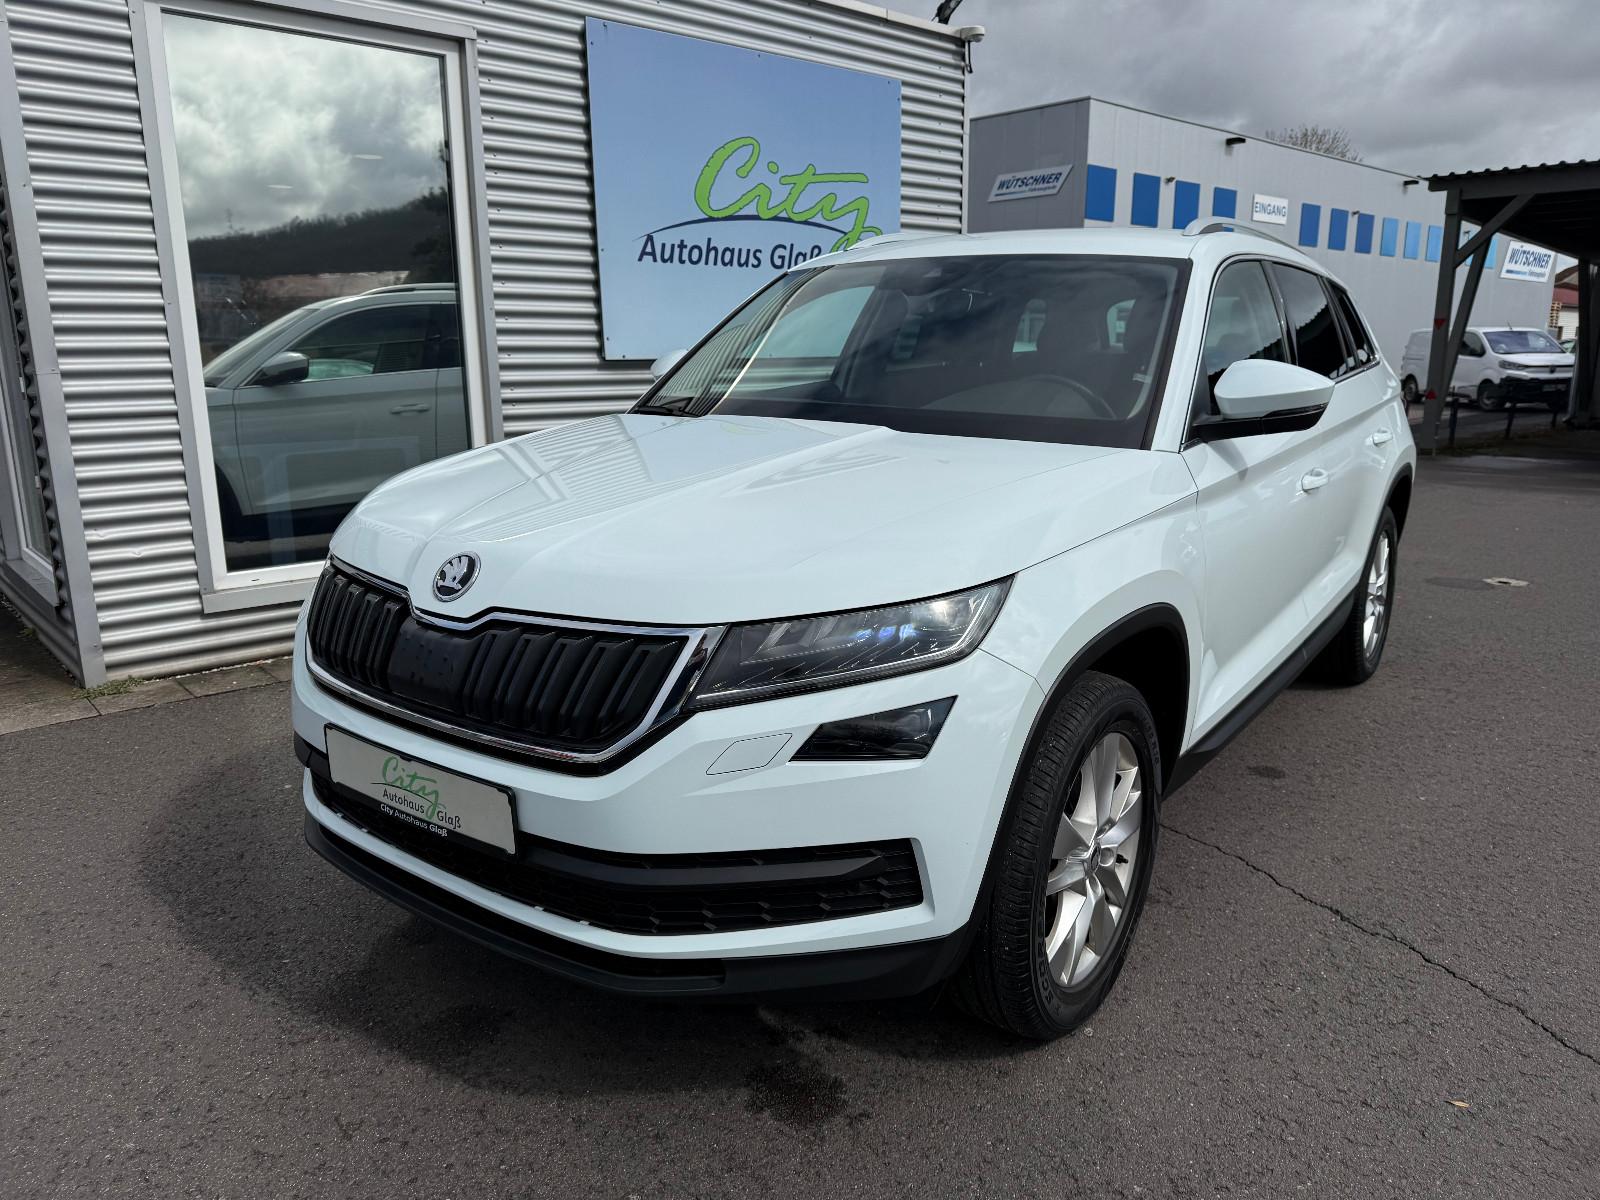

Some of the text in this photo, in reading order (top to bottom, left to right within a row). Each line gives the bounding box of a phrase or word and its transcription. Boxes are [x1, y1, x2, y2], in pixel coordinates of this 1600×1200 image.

[694, 136, 882, 253] City
[997, 172, 1063, 191] WÜTSCHNER
[1254, 201, 1287, 217] EINGANG
[637, 234, 763, 268] Autohaus
[382, 756, 447, 820] City
[380, 803, 448, 837] City Autohaus Glaß
[382, 788, 462, 830] Autohaus Glaß
